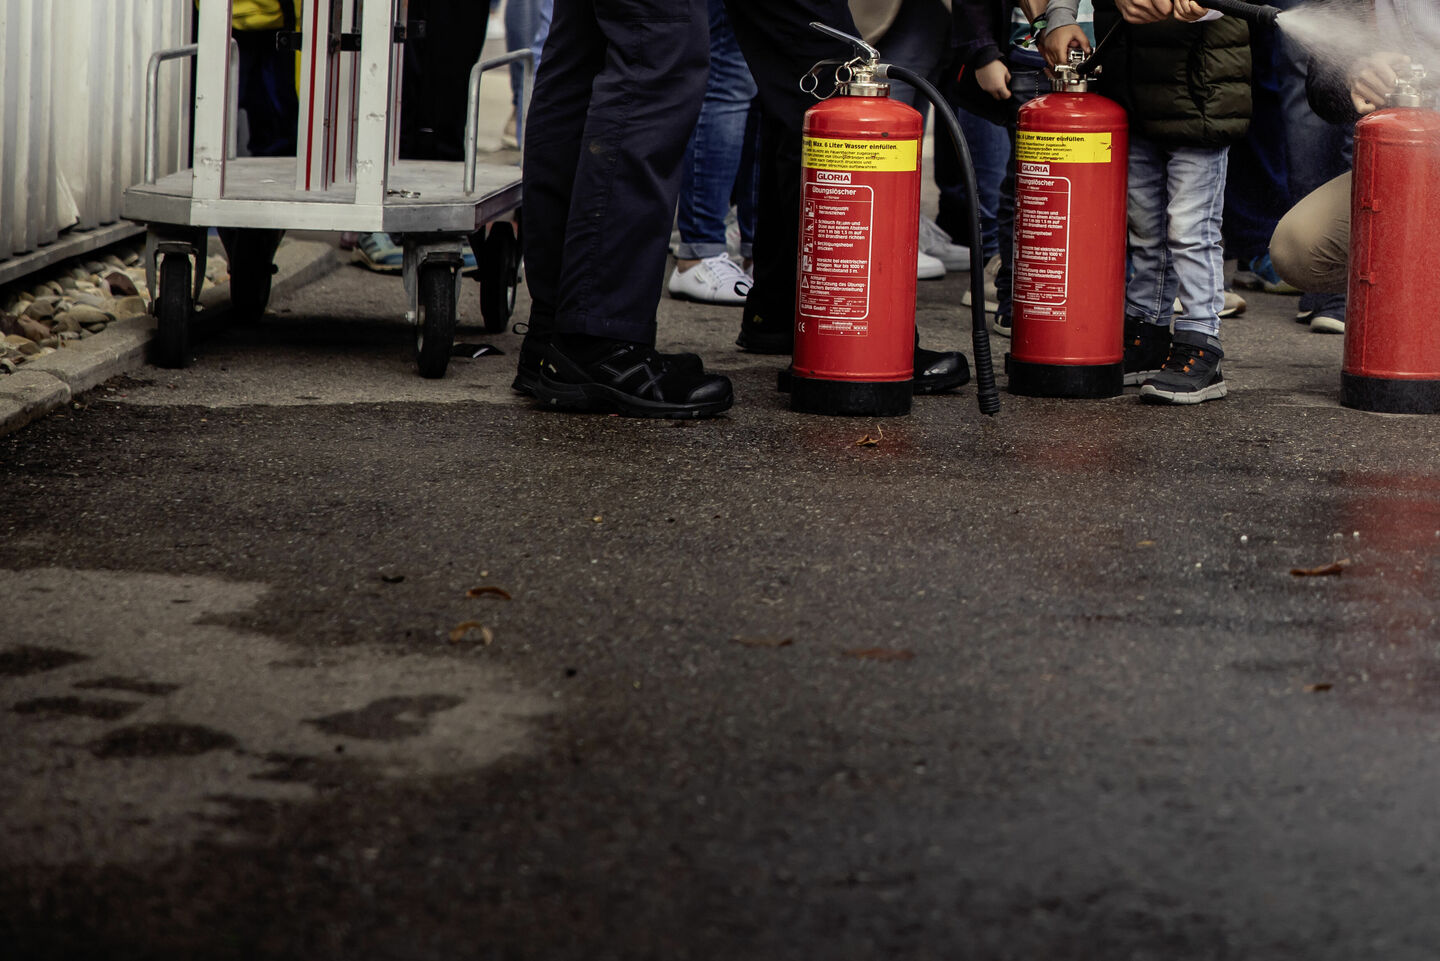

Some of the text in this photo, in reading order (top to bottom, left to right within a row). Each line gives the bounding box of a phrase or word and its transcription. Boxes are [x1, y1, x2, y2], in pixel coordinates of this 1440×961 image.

[1022, 164, 1048, 173] GLORIA
[817, 172, 850, 181] GLORIA
[812, 186, 856, 195] Übungslöscher
